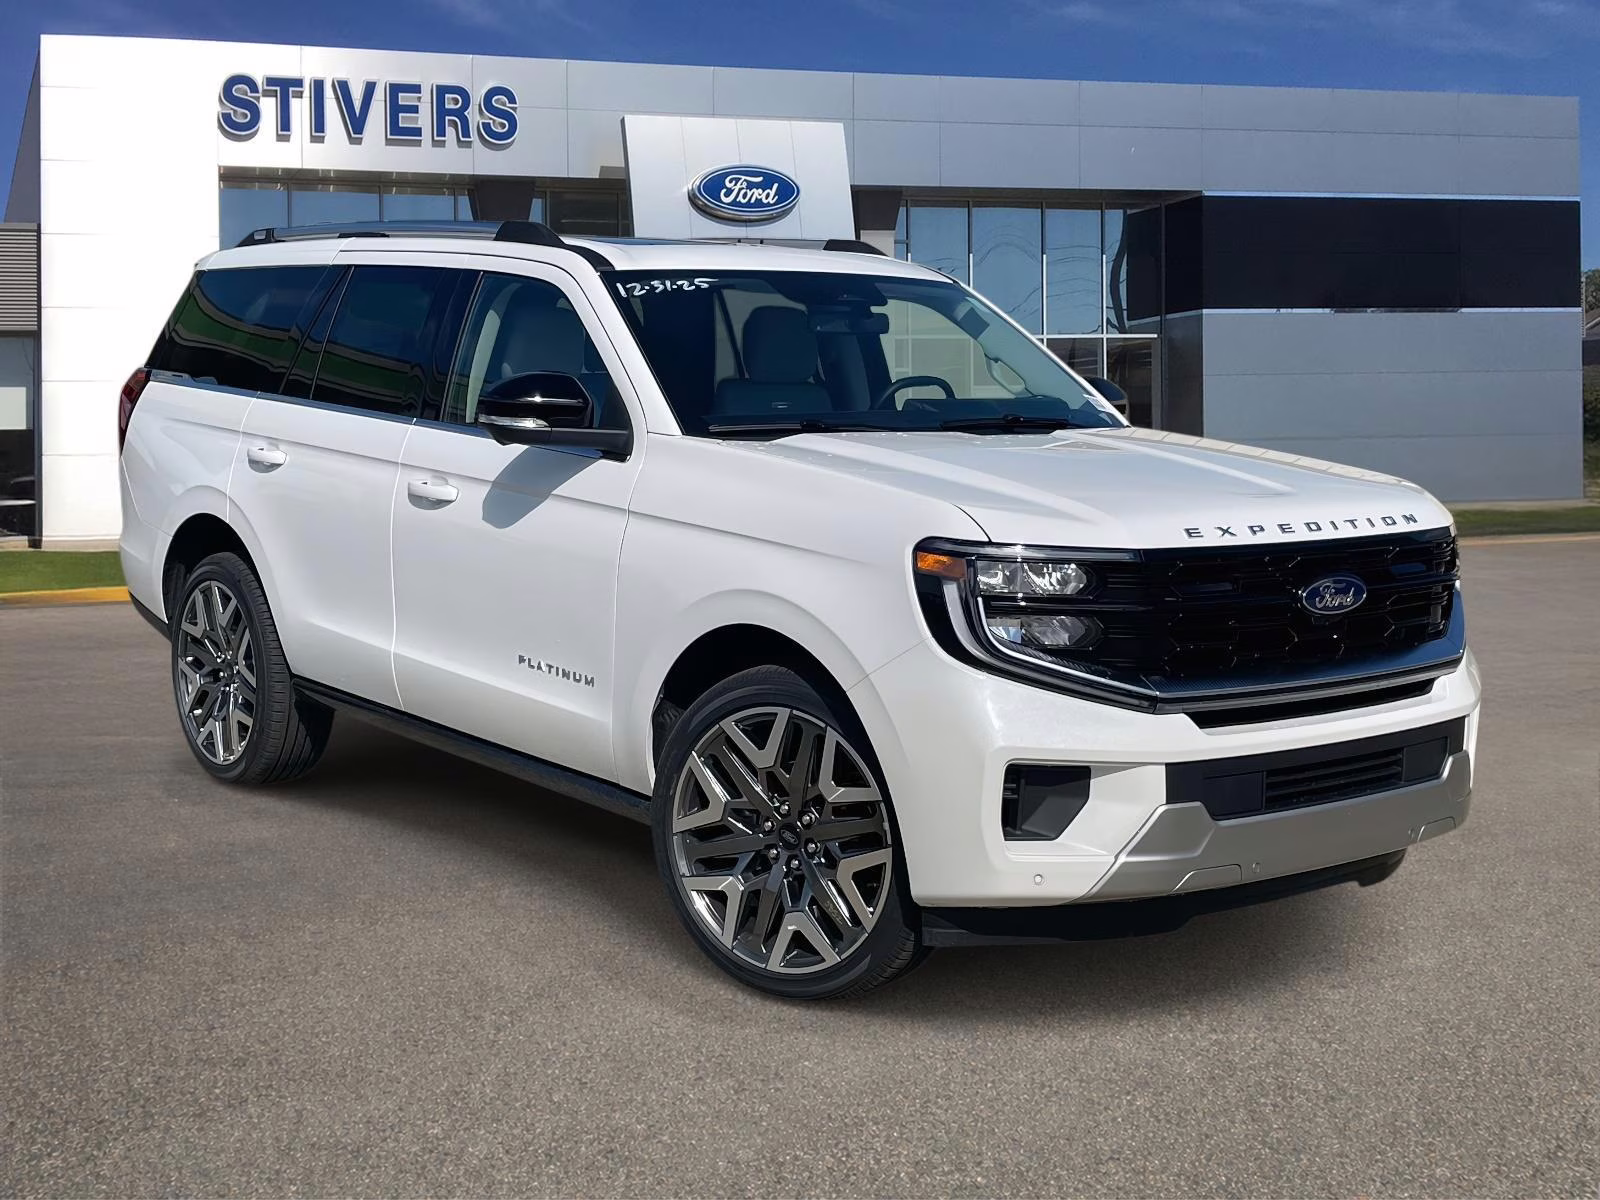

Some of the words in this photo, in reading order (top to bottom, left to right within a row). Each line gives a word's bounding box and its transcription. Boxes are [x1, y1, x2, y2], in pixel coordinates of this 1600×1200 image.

[218, 73, 518, 147] STIVERS
[720, 174, 778, 204] Ford
[1183, 512, 1419, 540] EXPEDITION
[1315, 582, 1355, 609] Ford
[518, 654, 595, 688] PLATINUM
